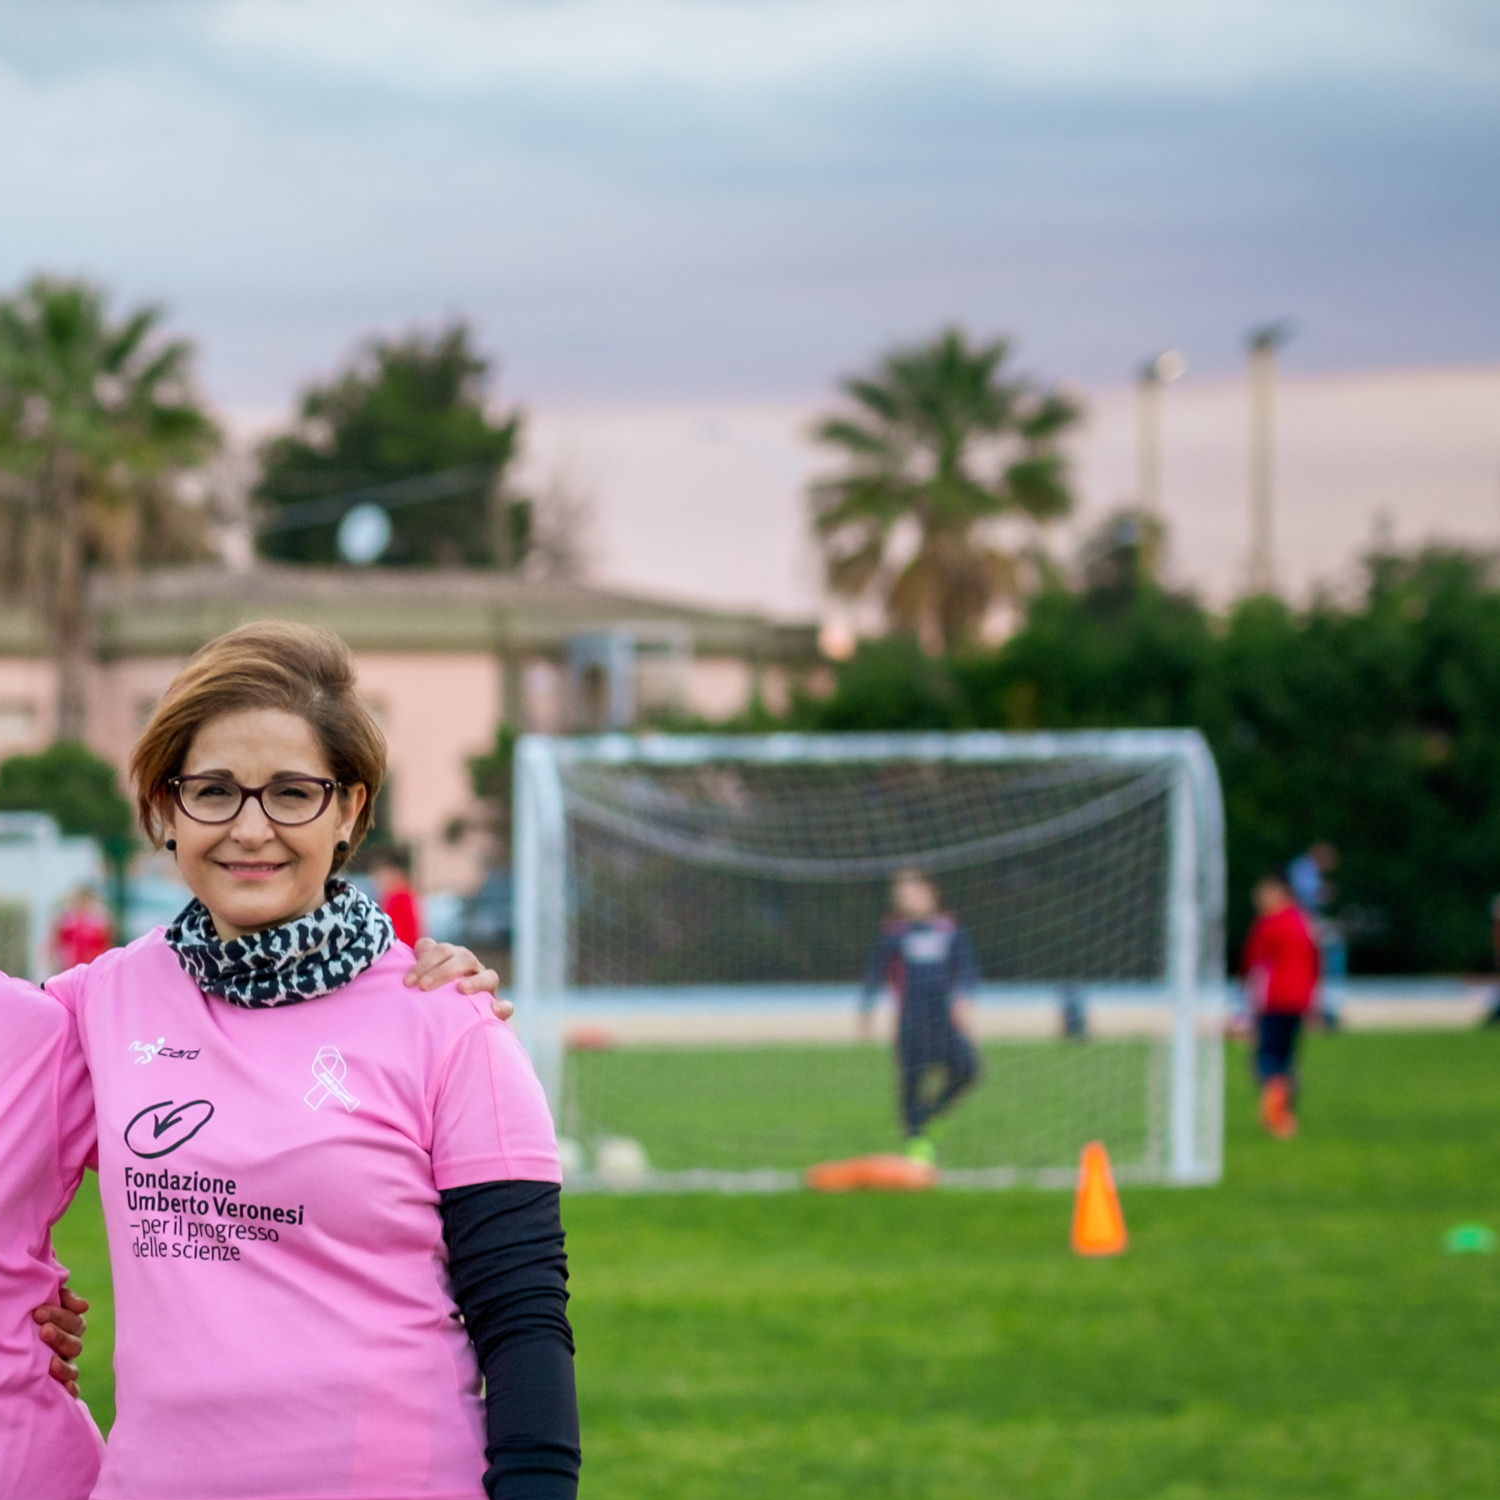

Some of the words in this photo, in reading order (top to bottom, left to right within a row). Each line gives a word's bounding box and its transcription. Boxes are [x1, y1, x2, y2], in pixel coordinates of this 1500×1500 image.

[125, 1167, 236, 1195] Fondazione
[127, 1191, 209, 1216] Umberto
[212, 1197, 304, 1226] Veronesi
[173, 1216, 183, 1236] il
[187, 1220, 279, 1243] progresso
[132, 1239, 168, 1258] delle
[171, 1240, 241, 1262] scienze
